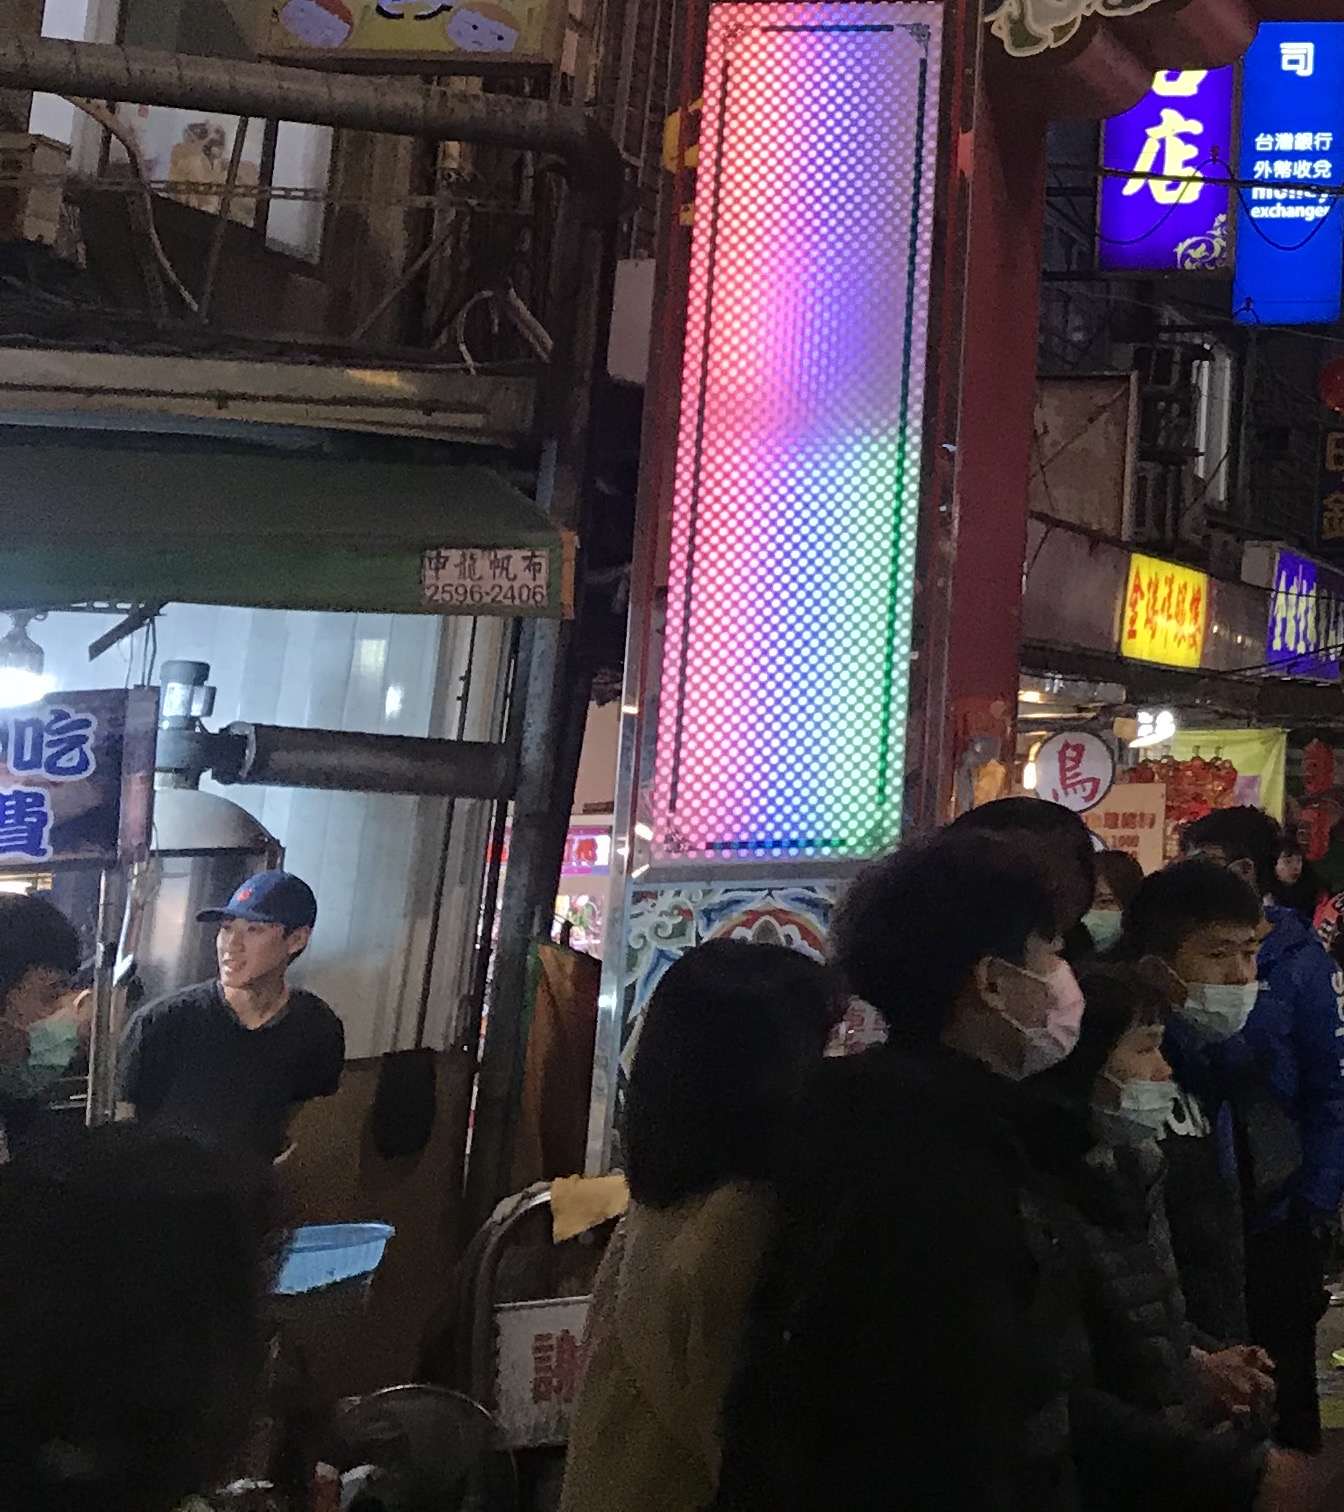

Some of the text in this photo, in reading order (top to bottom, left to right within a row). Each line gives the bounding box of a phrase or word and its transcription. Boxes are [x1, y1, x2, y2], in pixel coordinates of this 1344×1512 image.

[1279, 41, 1315, 77] 司
[1254, 132, 1333, 151] 台灣銀行
[427, 583, 546, 607] 2596-2406
